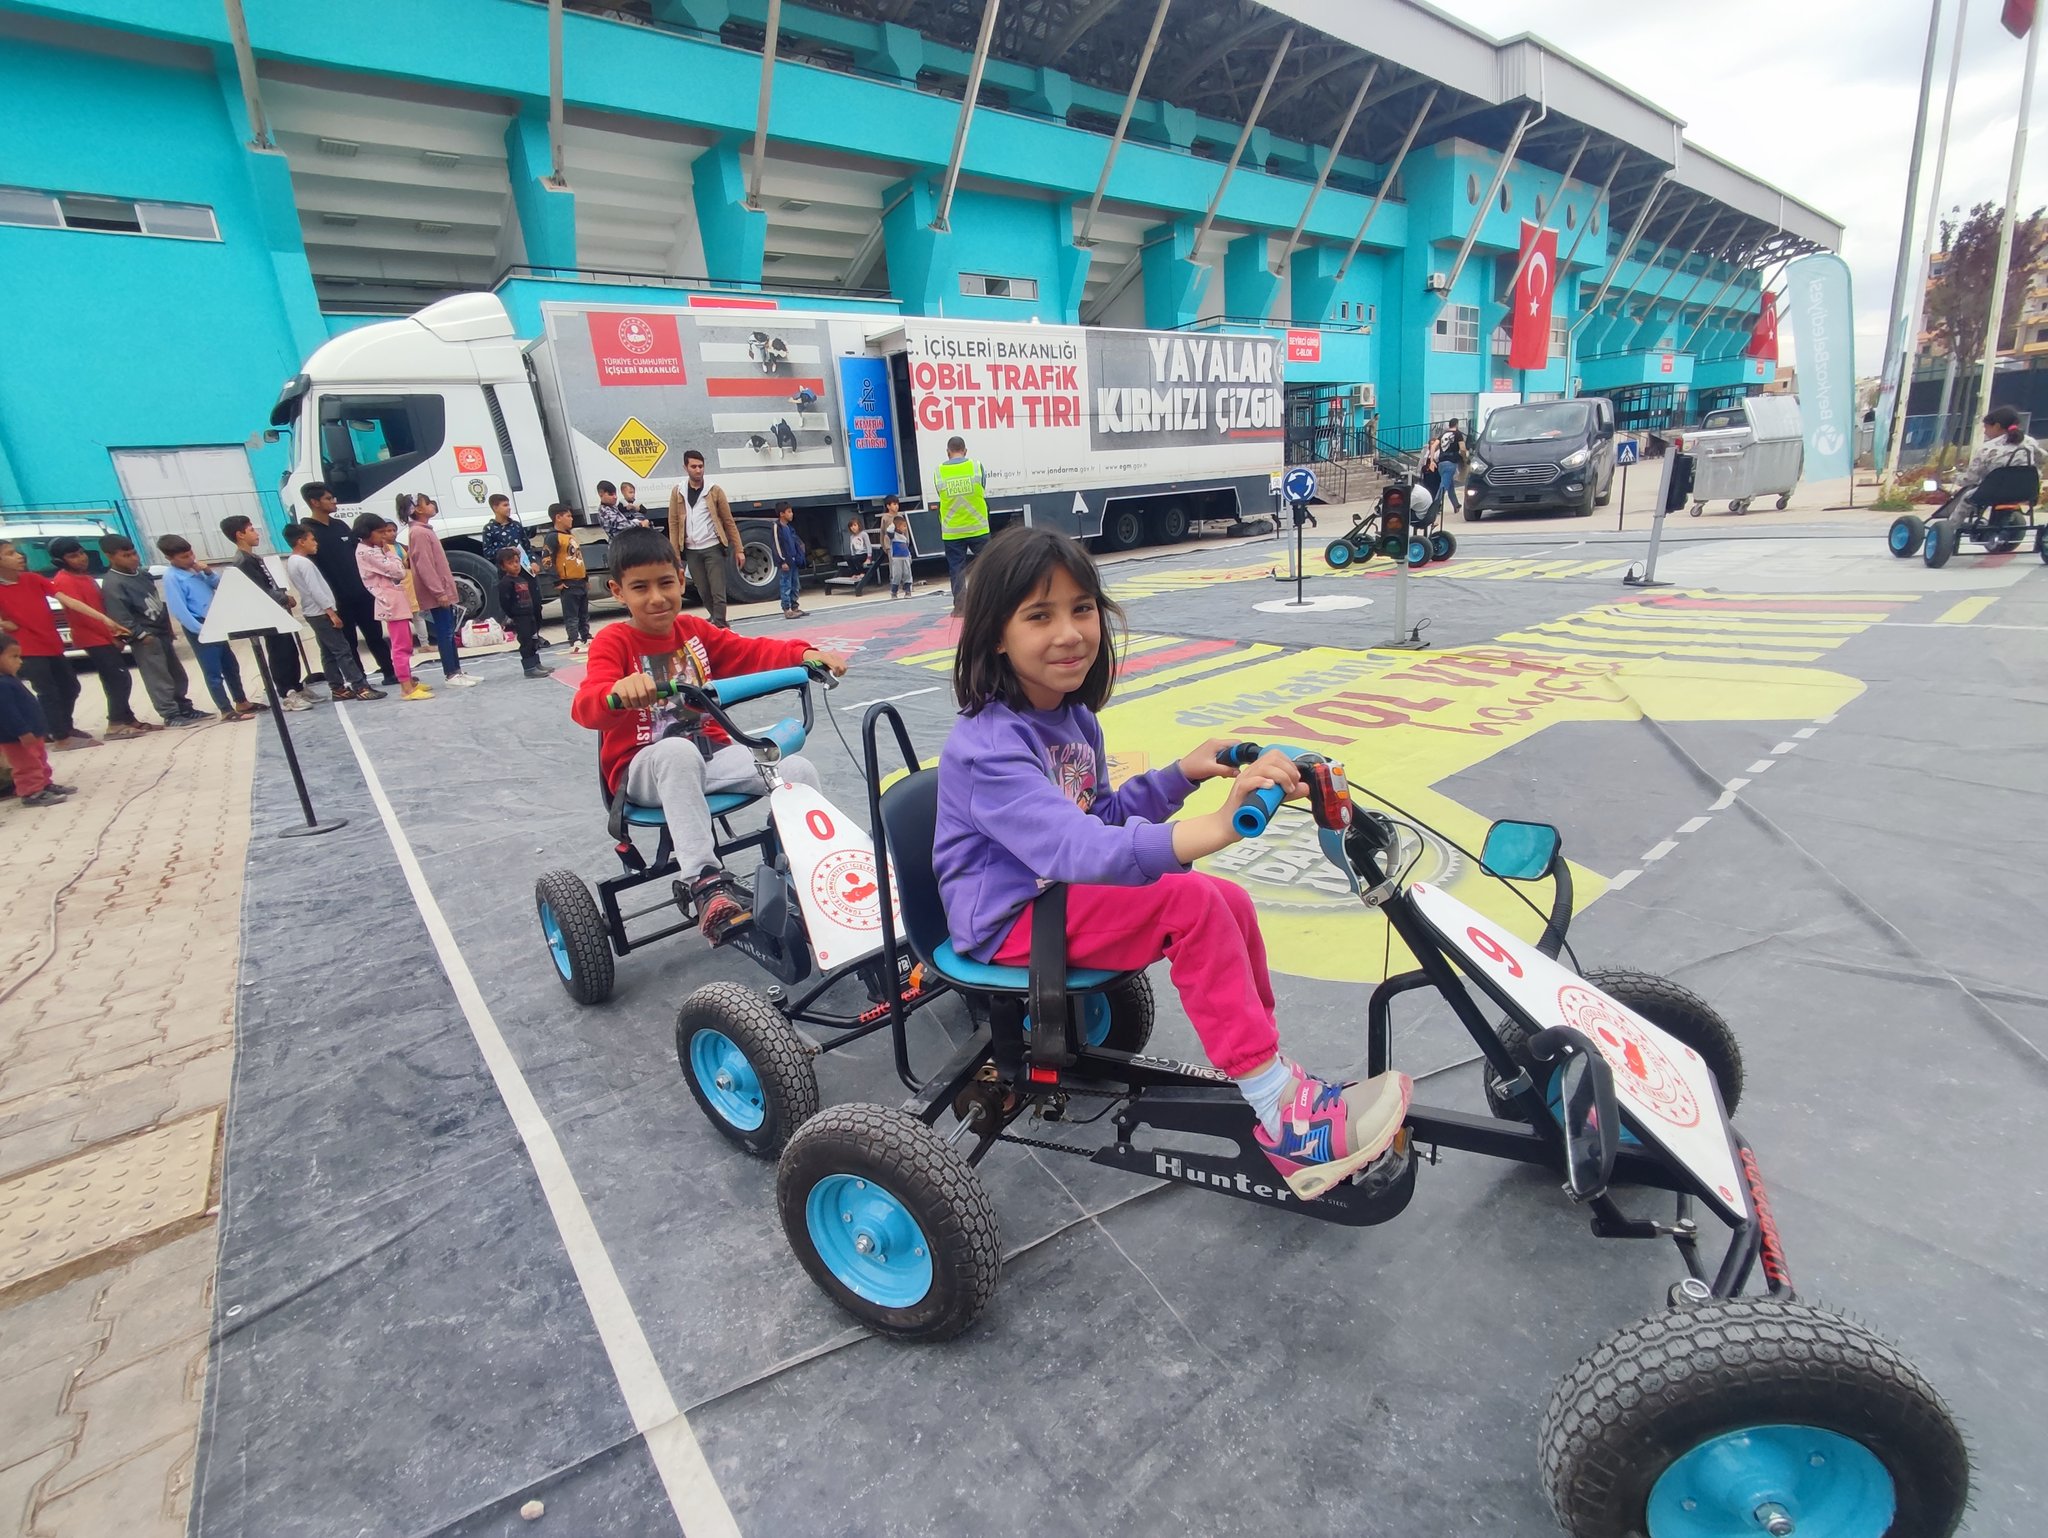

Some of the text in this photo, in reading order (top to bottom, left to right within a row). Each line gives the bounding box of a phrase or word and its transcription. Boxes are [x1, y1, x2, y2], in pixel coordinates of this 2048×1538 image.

[924, 335, 991, 359] İÇİŞLERİ
[998, 340, 1077, 359] BAKANLIĞI
[1148, 337, 1273, 383] YAYALAR
[638, 365, 680, 374] BAKANLIĞI
[908, 362, 1078, 391] OBİL TRAFİK
[1022, 396, 1081, 428] TIRI
[1097, 387, 1207, 433] KIRMIZI
[620, 439, 631, 447] BU
[632, 438, 653, 447] YOLDA
[1229, 648, 1567, 746] YOL VER
[805, 809, 836, 841] 0
[1466, 926, 1523, 978] 9
[1155, 1153, 1292, 1202] Hunter
